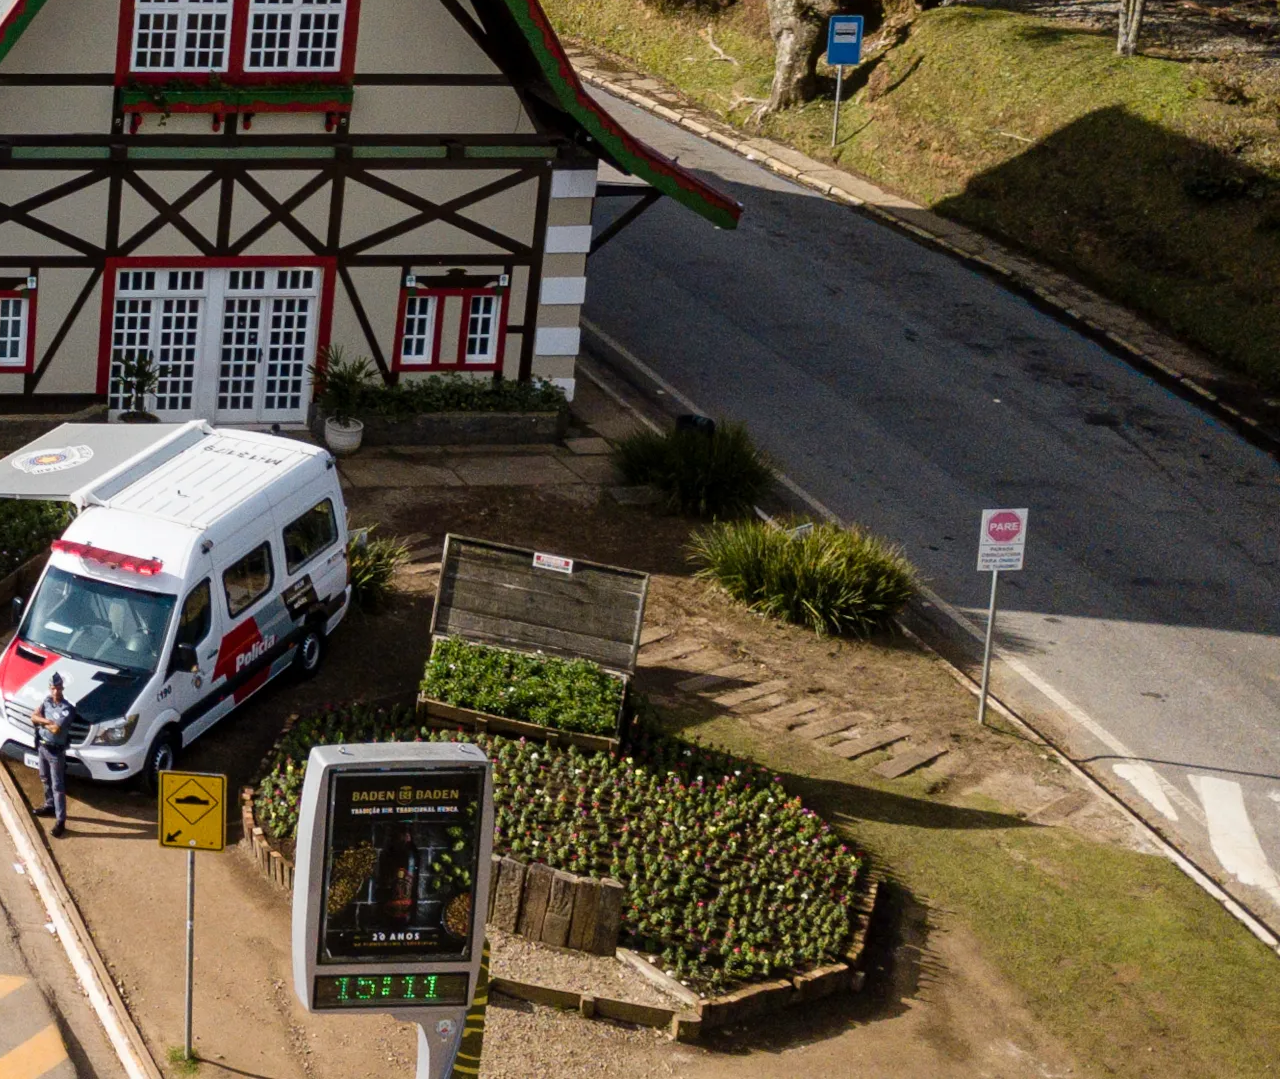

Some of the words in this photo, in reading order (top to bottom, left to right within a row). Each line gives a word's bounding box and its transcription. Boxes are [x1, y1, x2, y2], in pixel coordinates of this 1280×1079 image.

[989, 522, 1020, 532] PARE
[235, 633, 277, 673] Polícia
[352, 791, 395, 802] BADEN
[416, 789, 460, 800] BADEN
[372, 932, 386, 941] 20
[389, 932, 421, 941] ANOS
[335, 976, 438, 999] 15:11
